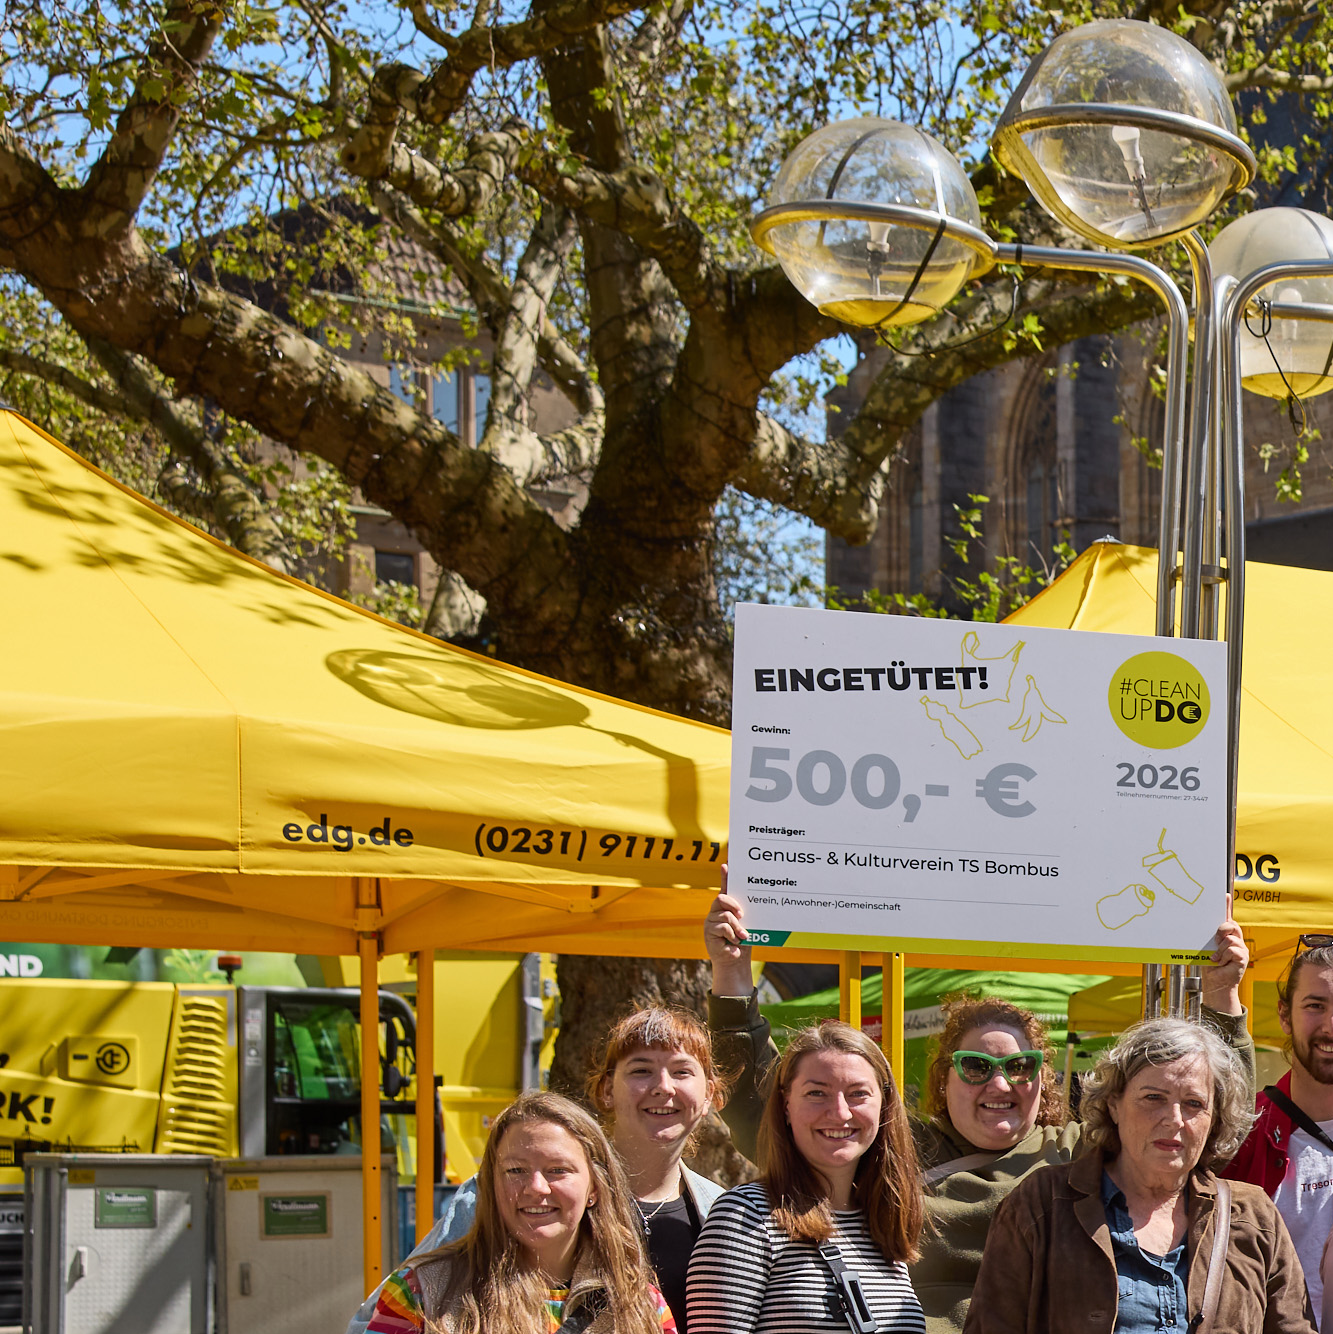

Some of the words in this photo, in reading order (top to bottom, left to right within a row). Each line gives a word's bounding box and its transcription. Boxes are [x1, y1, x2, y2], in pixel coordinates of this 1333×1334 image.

[754, 660, 989, 693] EINGETÜTET!
[1119, 678, 1201, 700] #CLEAN
[751, 724, 791, 736] Gewinn:
[1116, 762, 1201, 791] 2026
[975, 762, 1038, 818] €
[1116, 791, 1182, 801] Teilnehmernummer:
[282, 815, 414, 852] edg.de
[748, 825, 806, 838] Preisträger:
[748, 846, 822, 866] Genuss-
[827, 851, 840, 866] &
[844, 852, 954, 873] Kulturverein
[958, 858, 980, 873] TS
[985, 859, 1059, 878] Bombus
[747, 876, 797, 888] Kategorie:
[1243, 890, 1280, 902] GMBH
[747, 895, 779, 906] Verein,
[780, 897, 901, 913] (Anwohner-)Gemeinschaft
[745, 932, 770, 944] EDG
[1170, 953, 1184, 961] WIR
[1185, 954, 1200, 963] SIND
